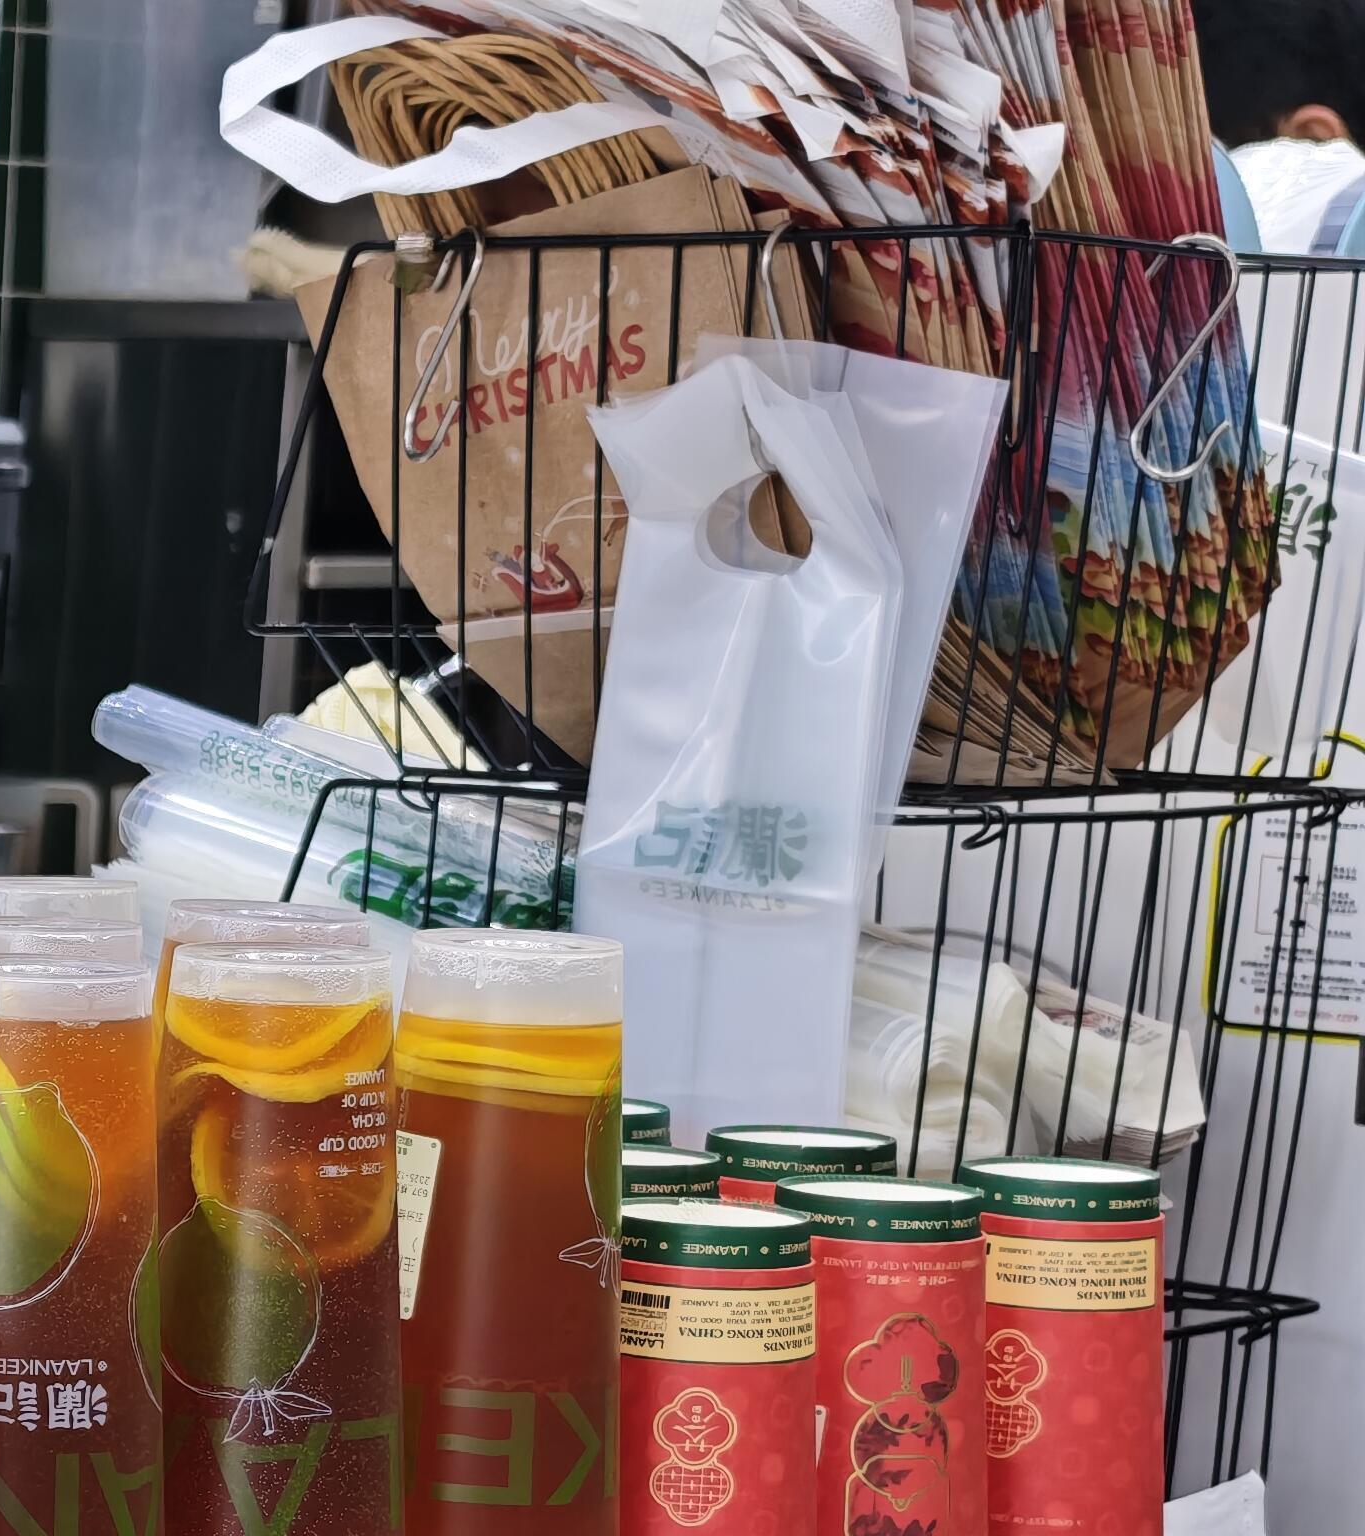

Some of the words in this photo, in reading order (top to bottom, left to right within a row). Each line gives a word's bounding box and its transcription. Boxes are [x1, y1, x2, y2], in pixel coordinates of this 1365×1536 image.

[410, 324, 647, 448] CHRISTMAS
[319, 1136, 343, 1152] CUP
[347, 1135, 377, 1150] GOOD
[682, 1243, 748, 1256] LAANKEE
[996, 1272, 1036, 1285] CHINA
[1039, 1277, 1077, 1287] KONG
[1081, 1278, 1116, 1287] HONG
[1077, 1291, 1126, 1300] BRANDS
[678, 1326, 724, 1338] CHINA
[727, 1329, 763, 1338] KONG
